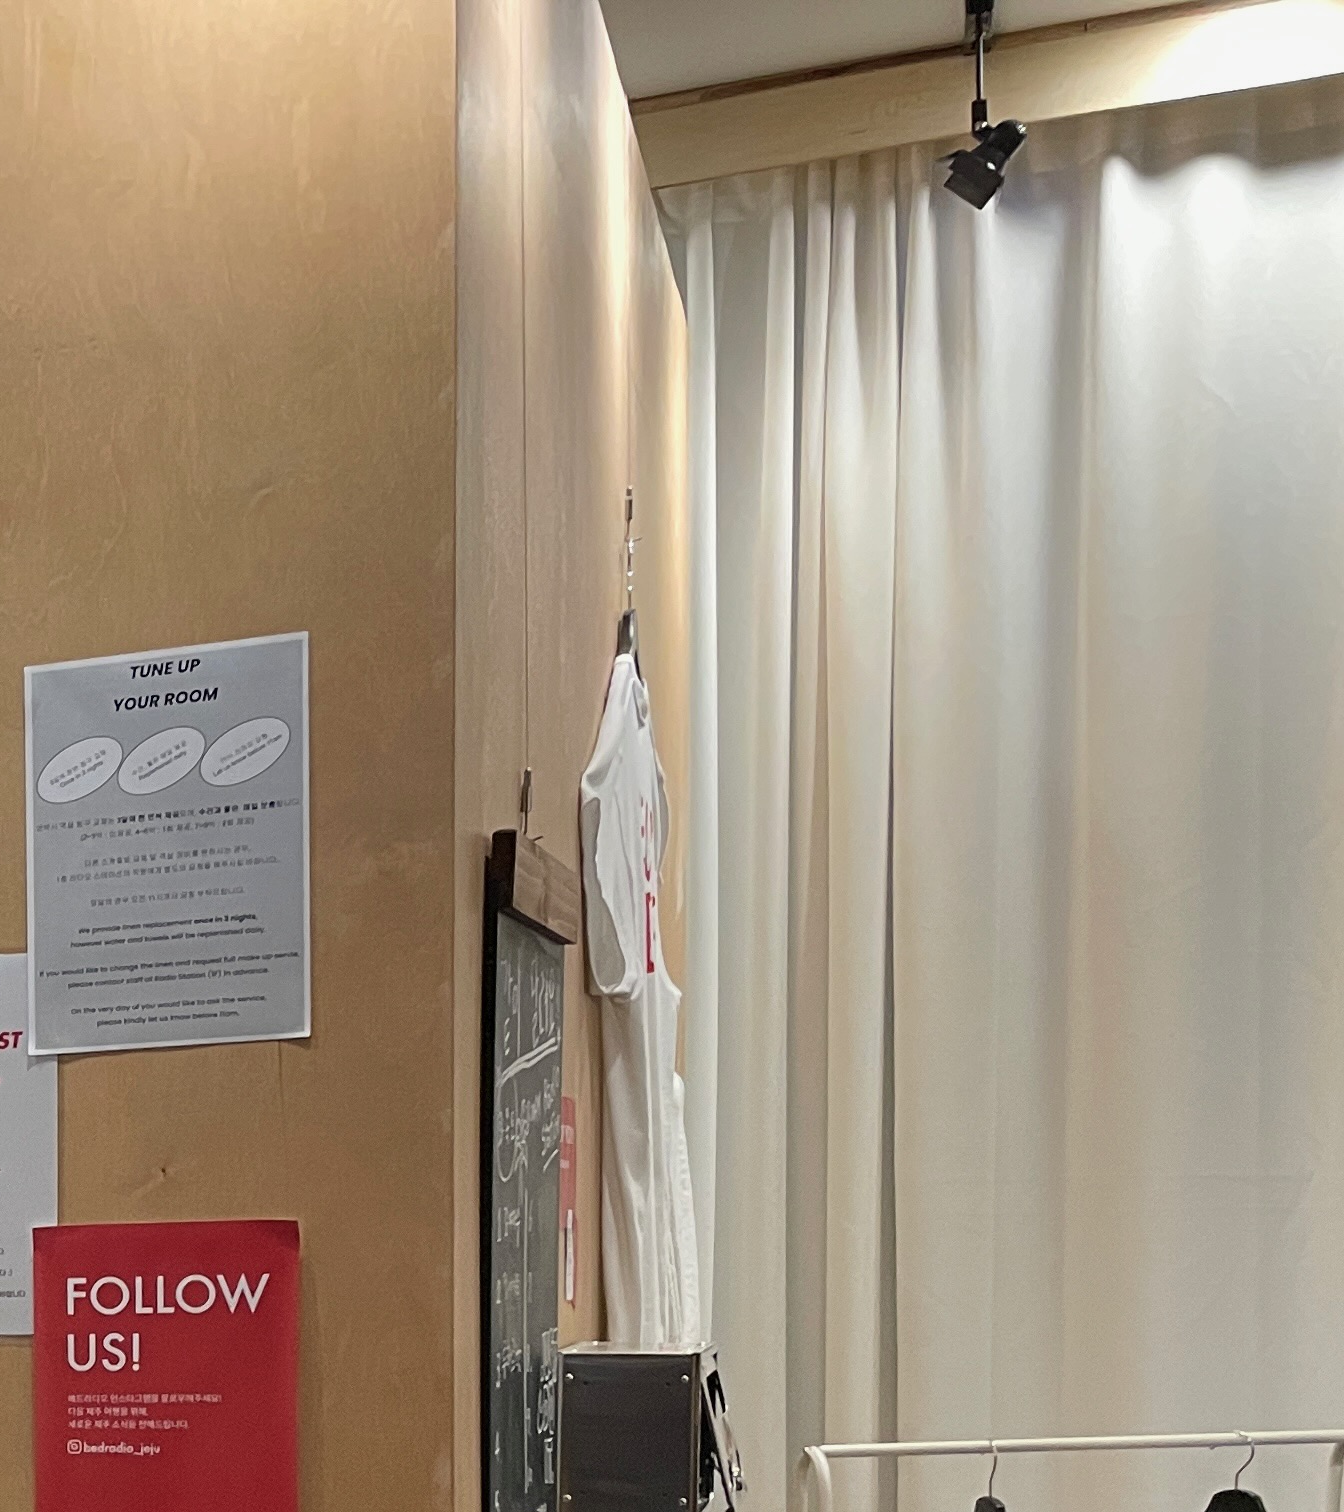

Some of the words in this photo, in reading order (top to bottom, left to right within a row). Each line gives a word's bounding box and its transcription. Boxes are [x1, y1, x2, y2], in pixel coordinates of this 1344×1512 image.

[130, 661, 173, 680] TUNE
[177, 658, 201, 675] UP
[114, 694, 160, 712] YOUR
[163, 687, 218, 706] ROOM
[66, 1273, 270, 1316] FOLLOW
[66, 1333, 140, 1371] US!
